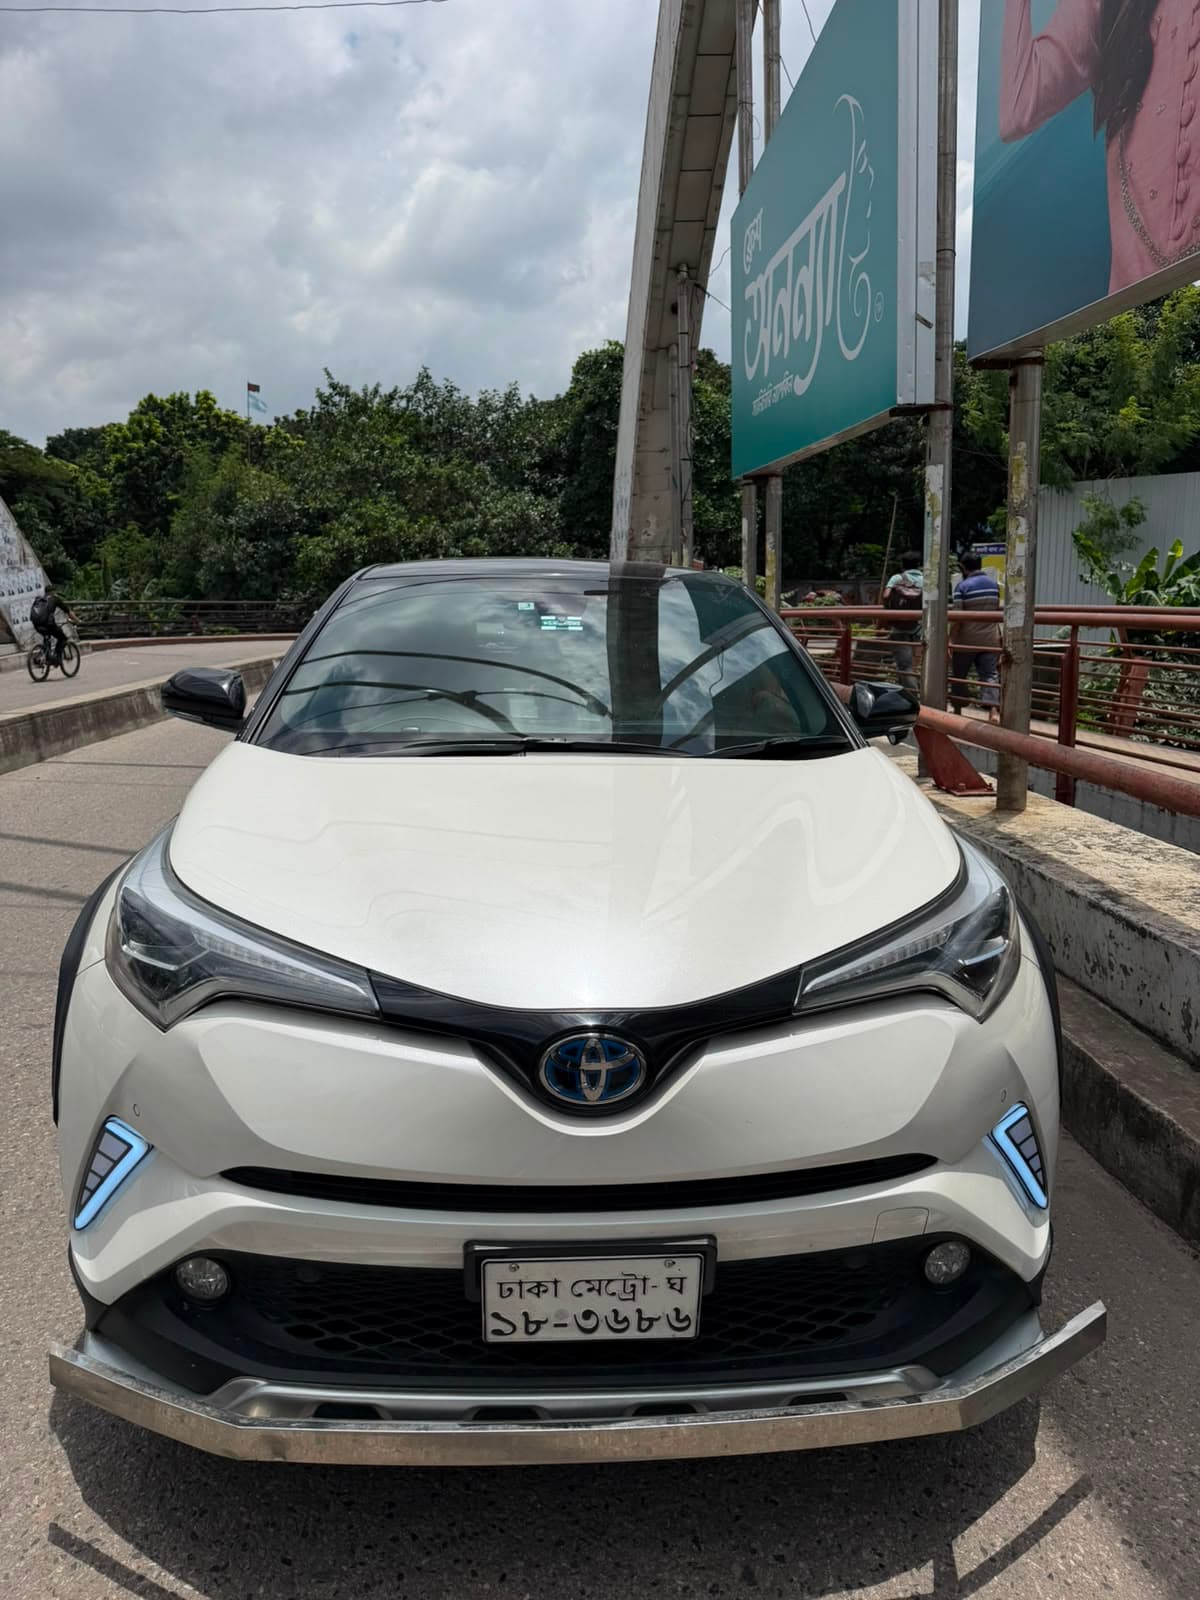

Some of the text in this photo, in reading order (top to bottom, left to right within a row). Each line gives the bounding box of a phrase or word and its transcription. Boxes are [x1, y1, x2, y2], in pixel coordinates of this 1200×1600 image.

[744, 171, 846, 396] অনন্যা
[496, 1277, 562, 1300] ঢাকা
[490, 1307, 692, 1336] ১৮-৩৬৮৬
